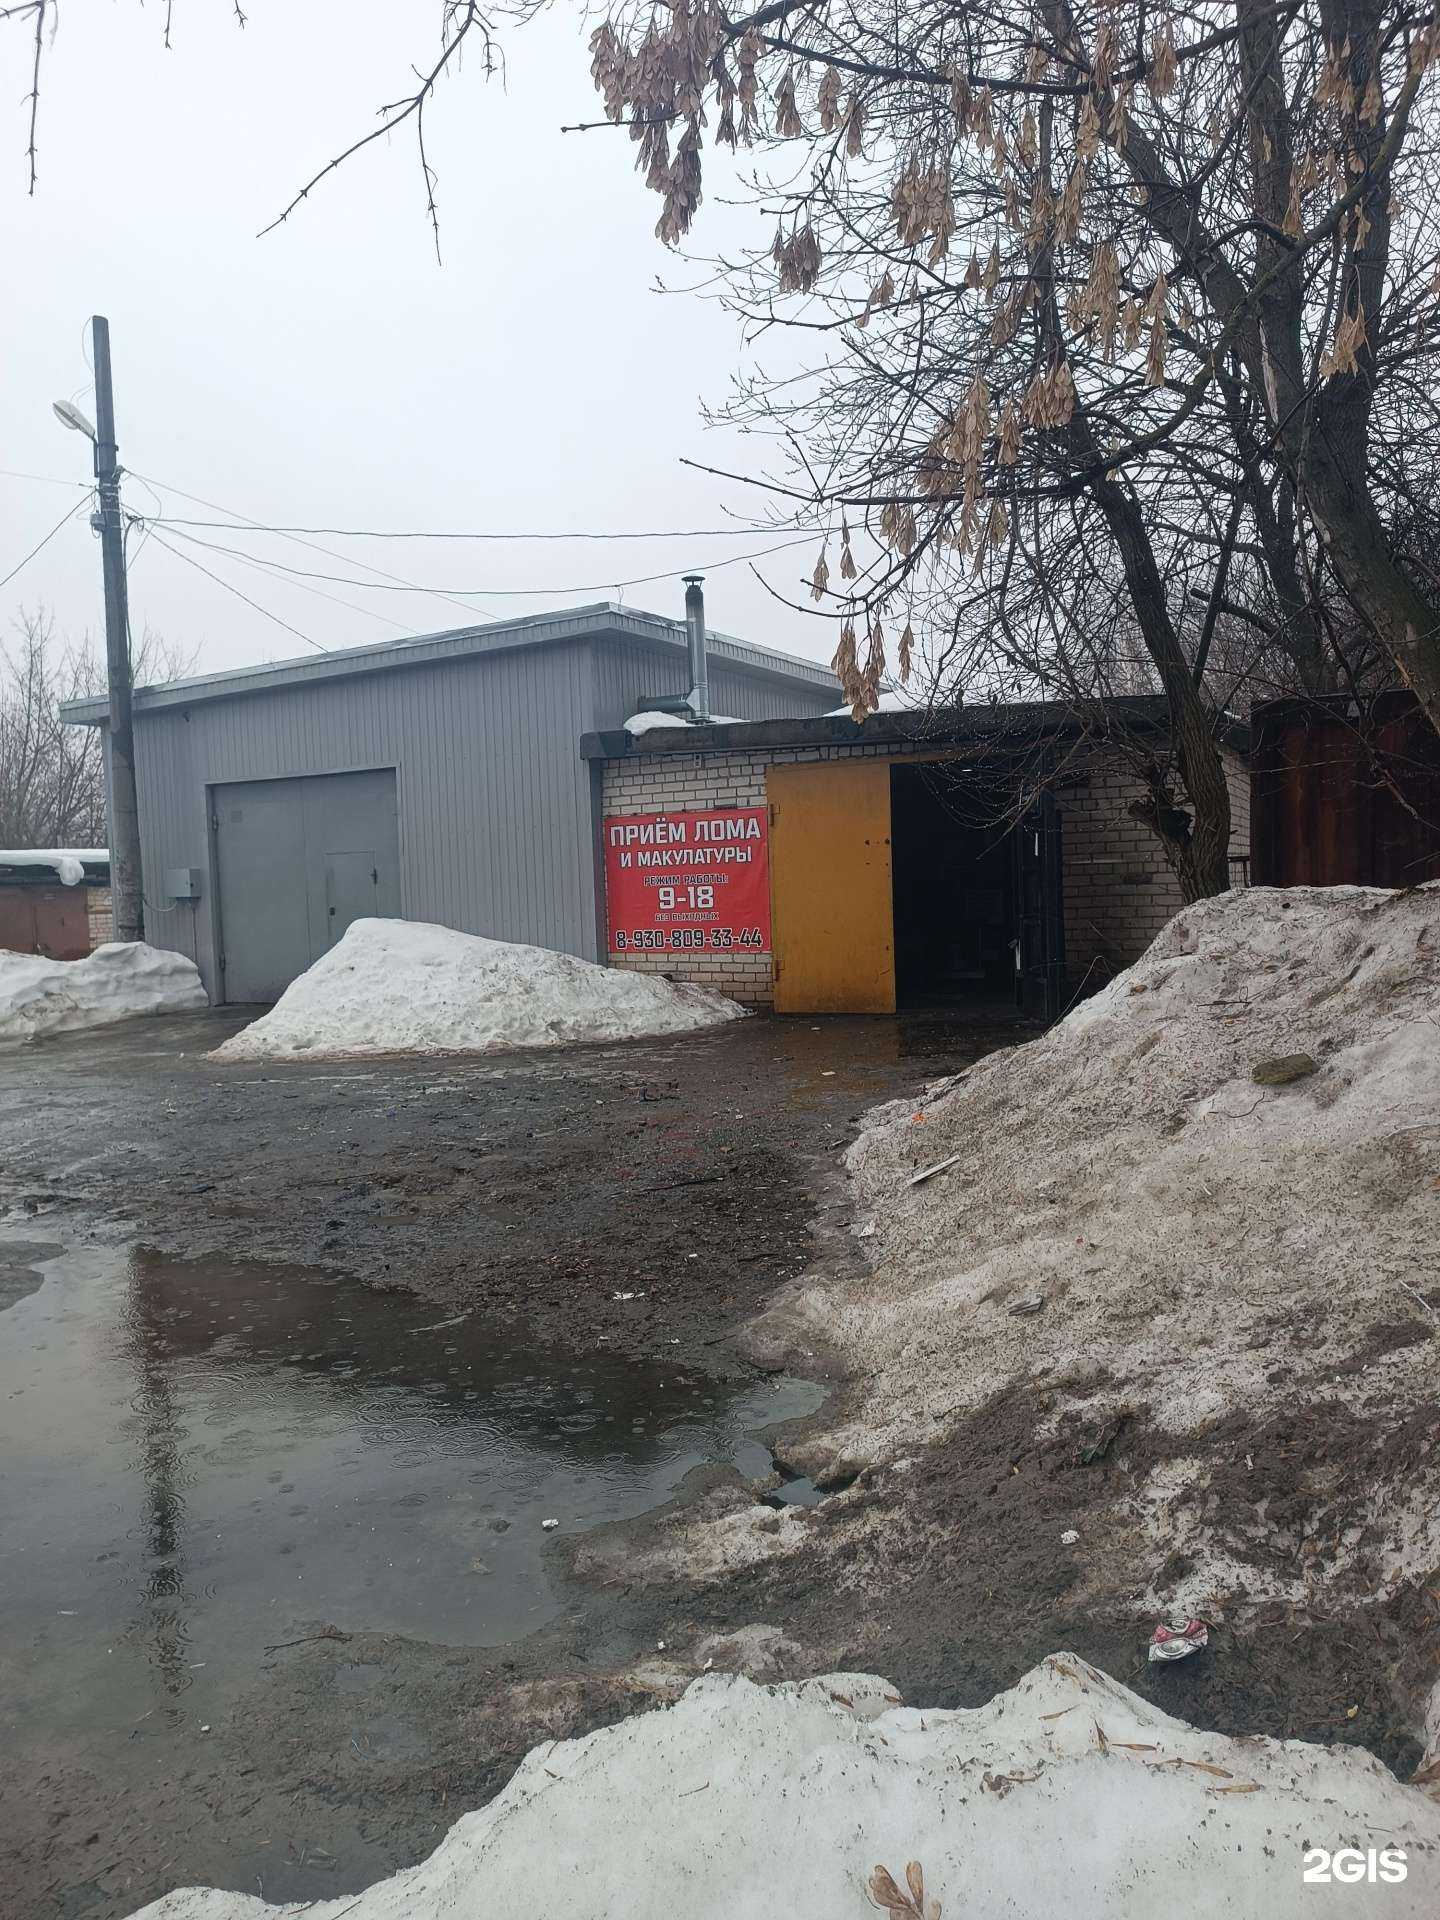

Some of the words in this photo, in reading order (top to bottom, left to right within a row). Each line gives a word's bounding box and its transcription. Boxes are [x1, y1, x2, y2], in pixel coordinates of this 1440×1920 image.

[610, 817, 686, 847] ПРИЁМ
[694, 817, 761, 842] ЛОМА
[620, 852, 632, 868] И
[637, 846, 752, 867] МАКУЛАТУРЫ
[644, 875, 680, 886] РЕЖИМ
[658, 885, 714, 910] 9-18
[655, 913, 670, 922] БЕЗ
[616, 927, 763, 949] 8-930-809-33-44
